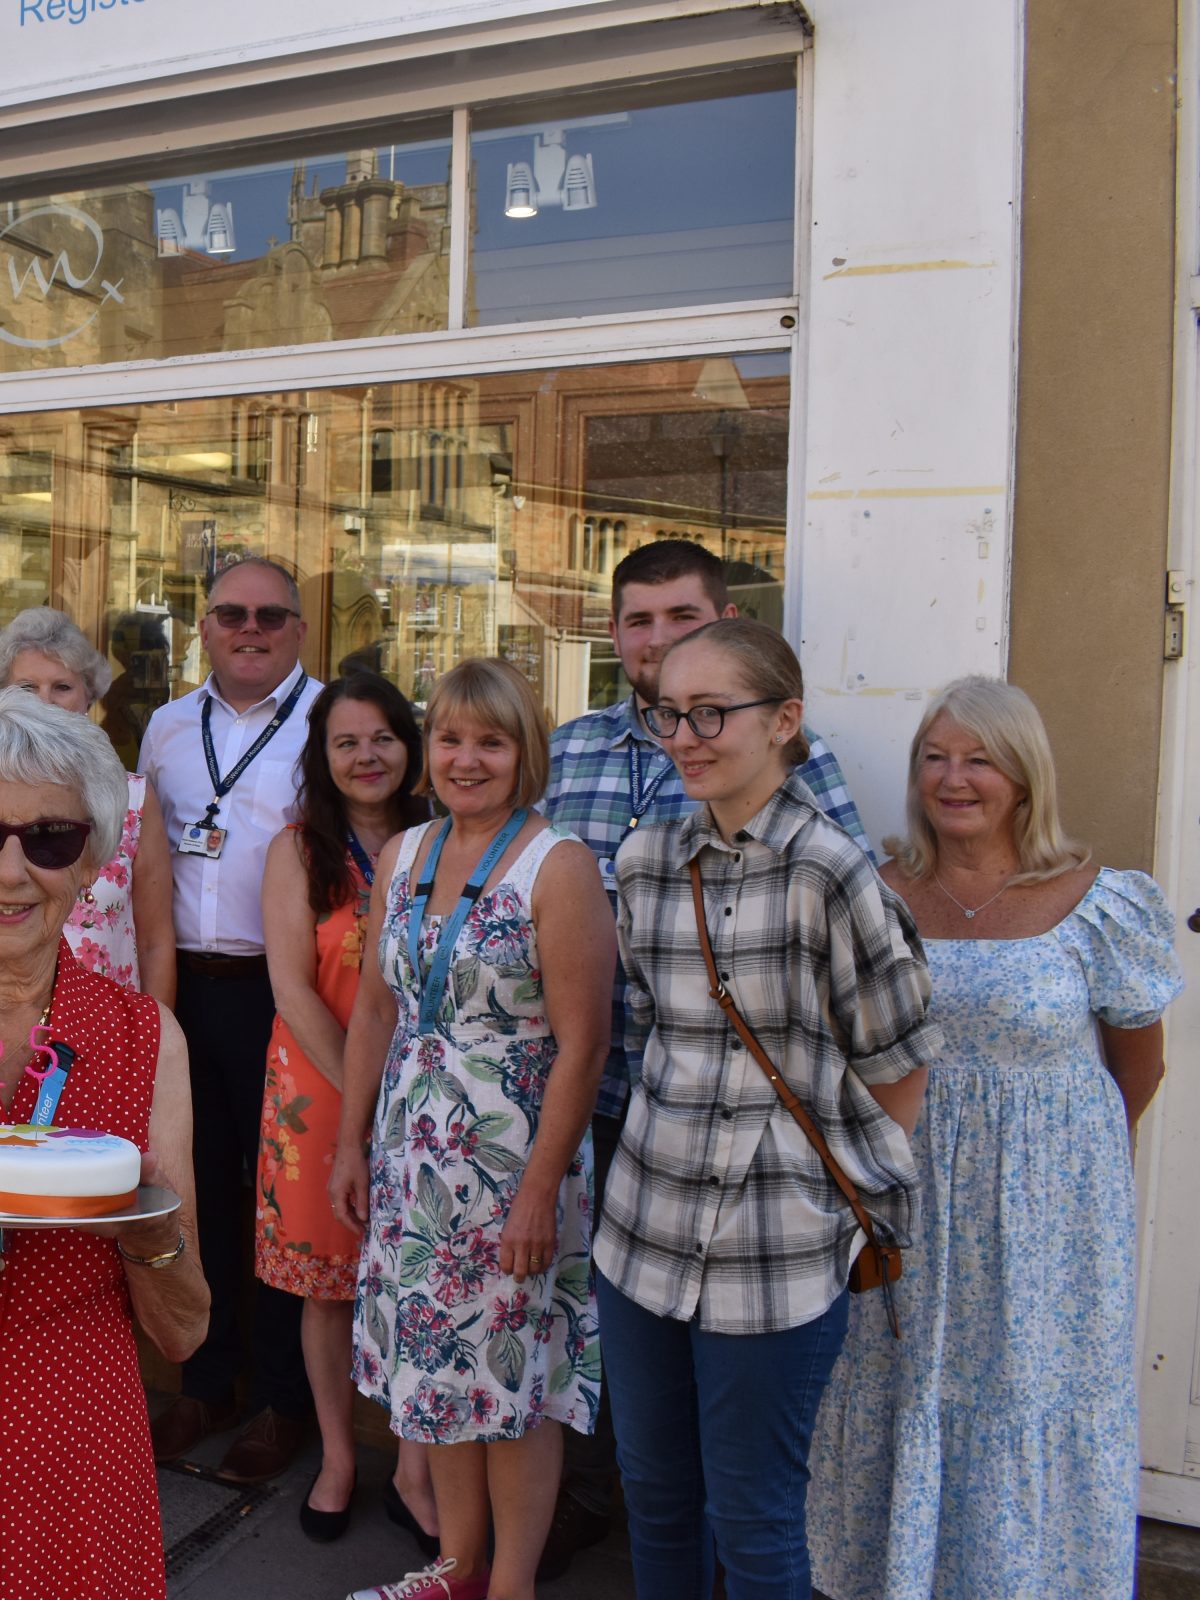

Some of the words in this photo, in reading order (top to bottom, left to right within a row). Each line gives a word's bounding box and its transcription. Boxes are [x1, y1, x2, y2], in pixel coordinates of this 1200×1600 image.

[230, 757, 250, 783] Weldmar
[248, 727, 275, 759] Hospicecare
[481, 832, 509, 872] VOLUNTEER
